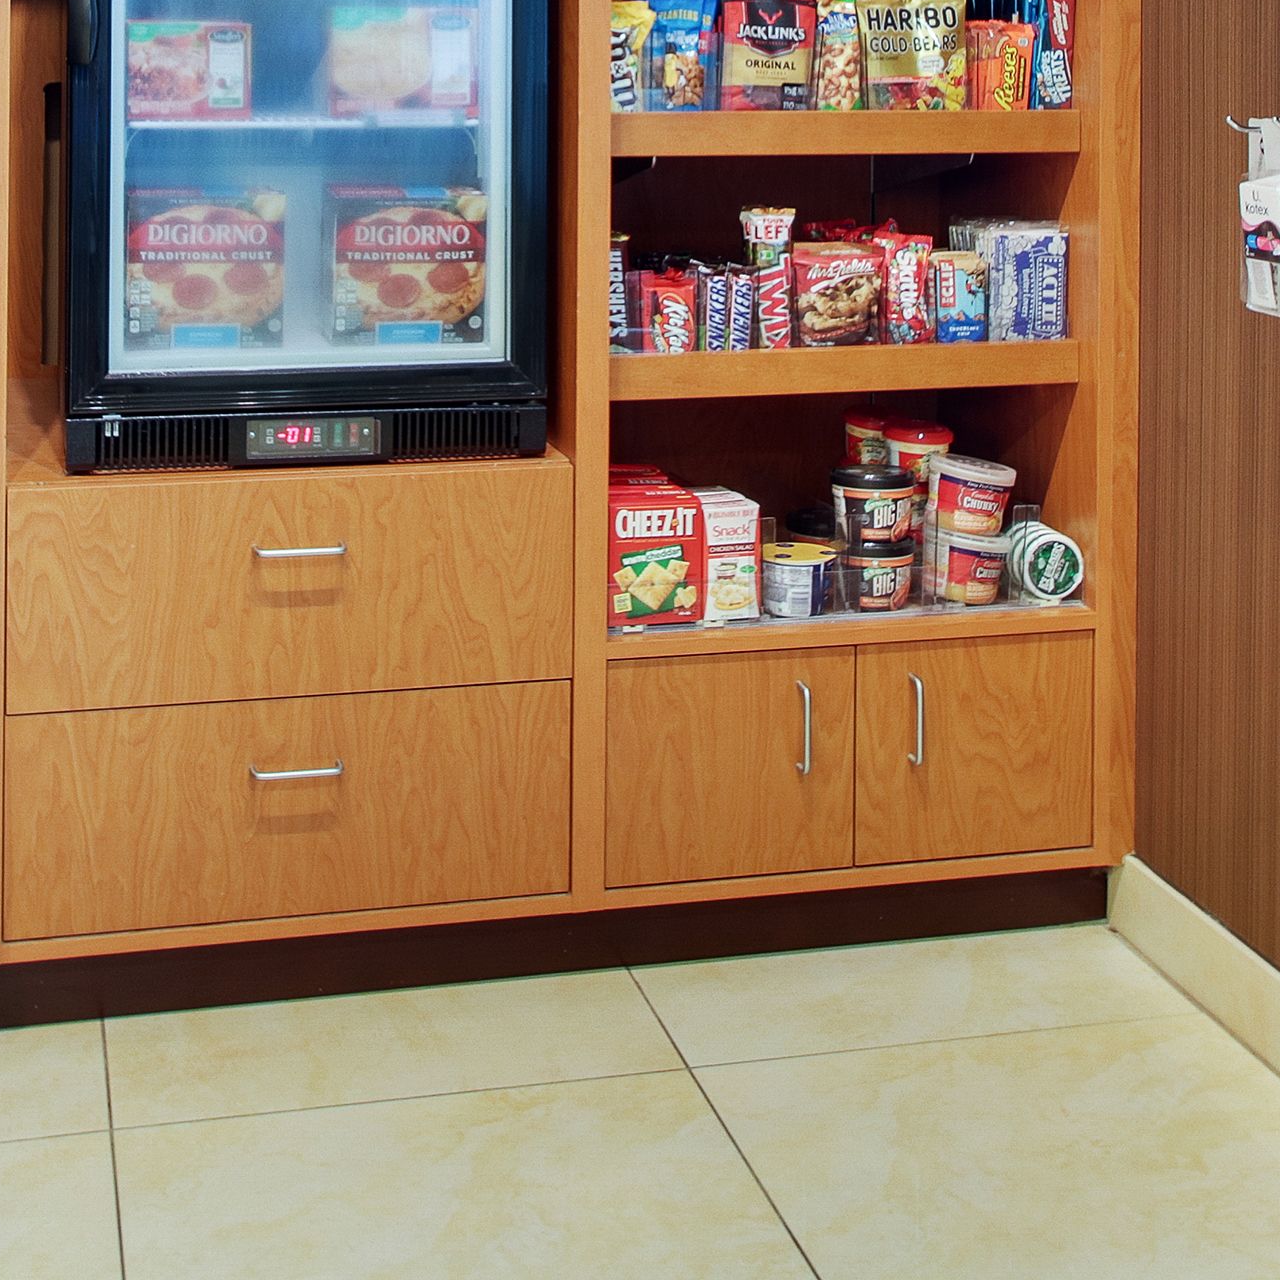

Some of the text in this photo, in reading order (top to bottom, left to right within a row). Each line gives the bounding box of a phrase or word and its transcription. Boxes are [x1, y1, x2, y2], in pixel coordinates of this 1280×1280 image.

[658, 10, 699, 20] PLANTERS
[867, 6, 957, 32] HARIBO
[737, 23, 768, 40] JACK
[818, 17, 857, 35] DIAMOND
[870, 34, 957, 54] GOLD-BEARS
[745, 58, 797, 71] ORIGINAL
[1051, 49, 1072, 103] TREATS
[140, 250, 274, 261] TRADITIONAL CRUST
[346, 250, 475, 261] TRADITIONAL CRUST
[832, 257, 875, 278] Fields
[896, 250, 918, 320] Skittles
[939, 263, 955, 297] CLIF
[1041, 263, 1057, 301] ACT
[708, 275, 727, 351] SNICKERS
[732, 278, 753, 351] SNICKERS
[963, 496, 1000, 514] CHUNKY
[873, 504, 896, 529] BIG
[712, 524, 750, 537] Snack
[646, 546, 681, 560] cheddar
[872, 574, 895, 598] BIG
